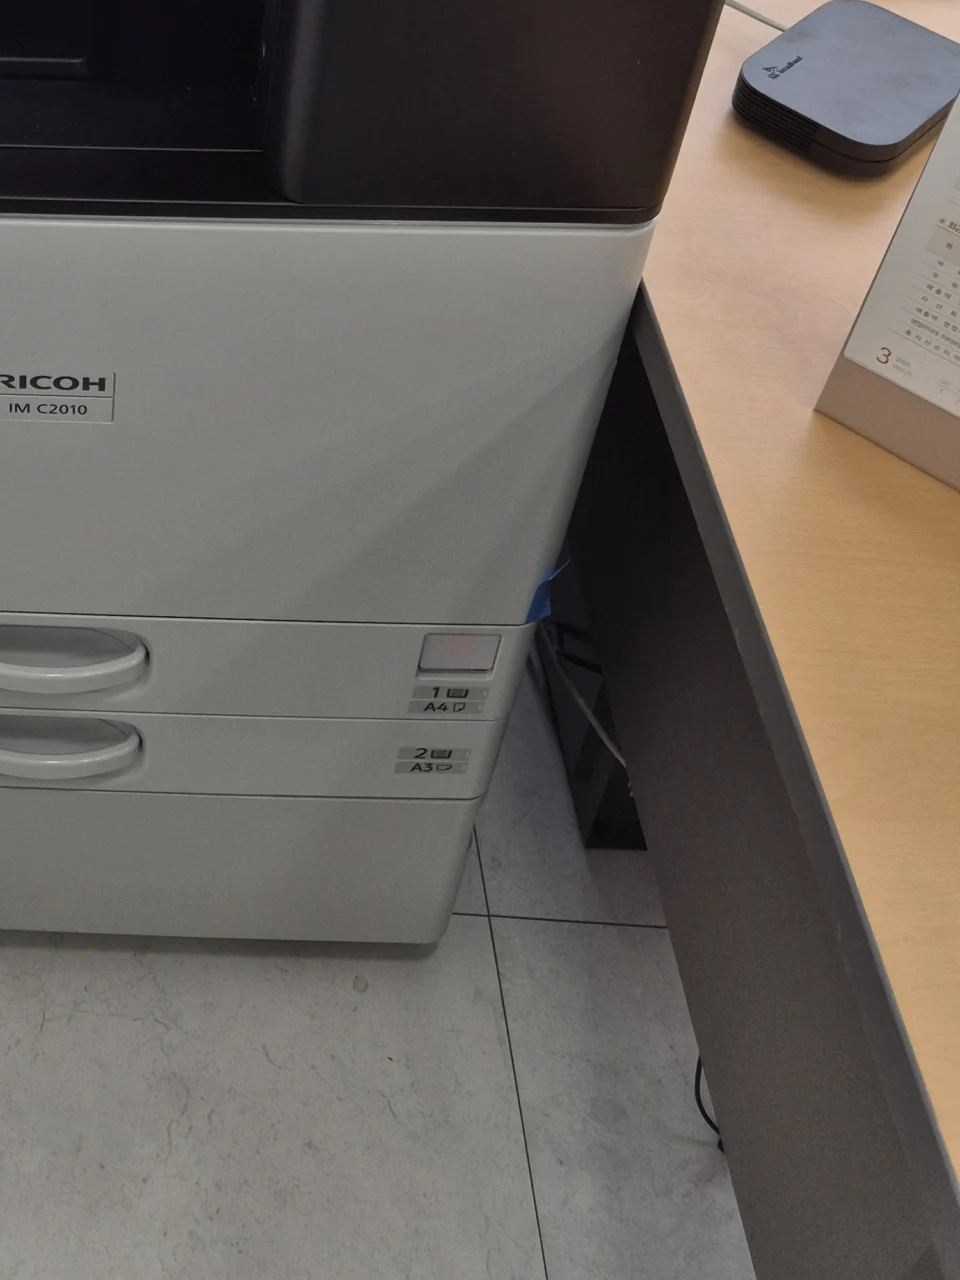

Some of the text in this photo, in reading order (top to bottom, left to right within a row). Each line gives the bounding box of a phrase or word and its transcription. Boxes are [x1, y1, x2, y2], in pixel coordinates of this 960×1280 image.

[876, 346, 892, 364] 3
[9, 403, 88, 415] IM C2010
[432, 686, 440, 698] 1
[423, 702, 448, 712] A4
[414, 747, 428, 759] 2
[410, 763, 433, 772] A3
